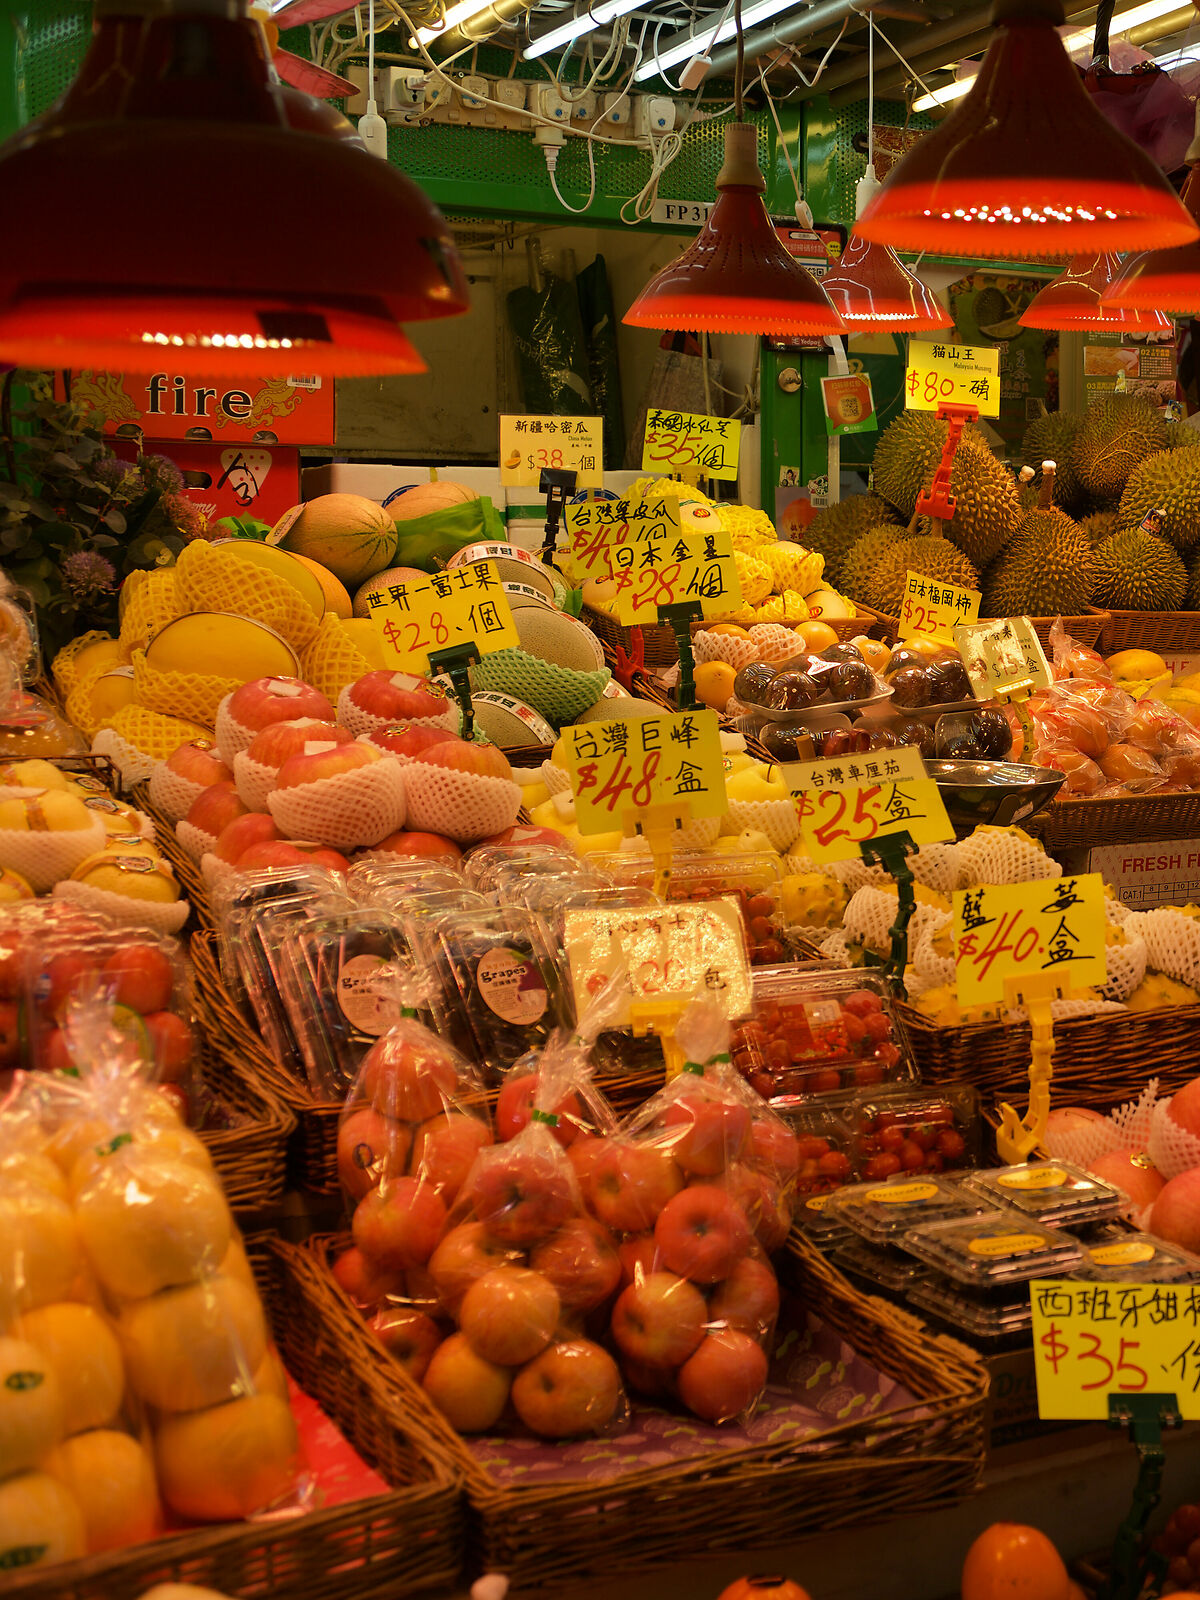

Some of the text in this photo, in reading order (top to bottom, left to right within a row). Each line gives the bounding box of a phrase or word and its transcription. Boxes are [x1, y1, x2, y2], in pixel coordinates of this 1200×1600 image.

[665, 204, 688, 220] FP
[145, 373, 254, 419] fire
[515, 420, 589, 434] 新疆哈密瓜
[366, 562, 498, 612] 世界一富士果
[908, 578, 972, 616] 日本福岡柿
[572, 717, 700, 760] 台灣巨峰
[673, 761, 709, 796] 盒
[811, 759, 900, 787] 台灣車厘茄
[1122, 854, 1181, 873] FRESH
[1122, 889, 1142, 900] CAT.1
[480, 966, 527, 983] grapes
